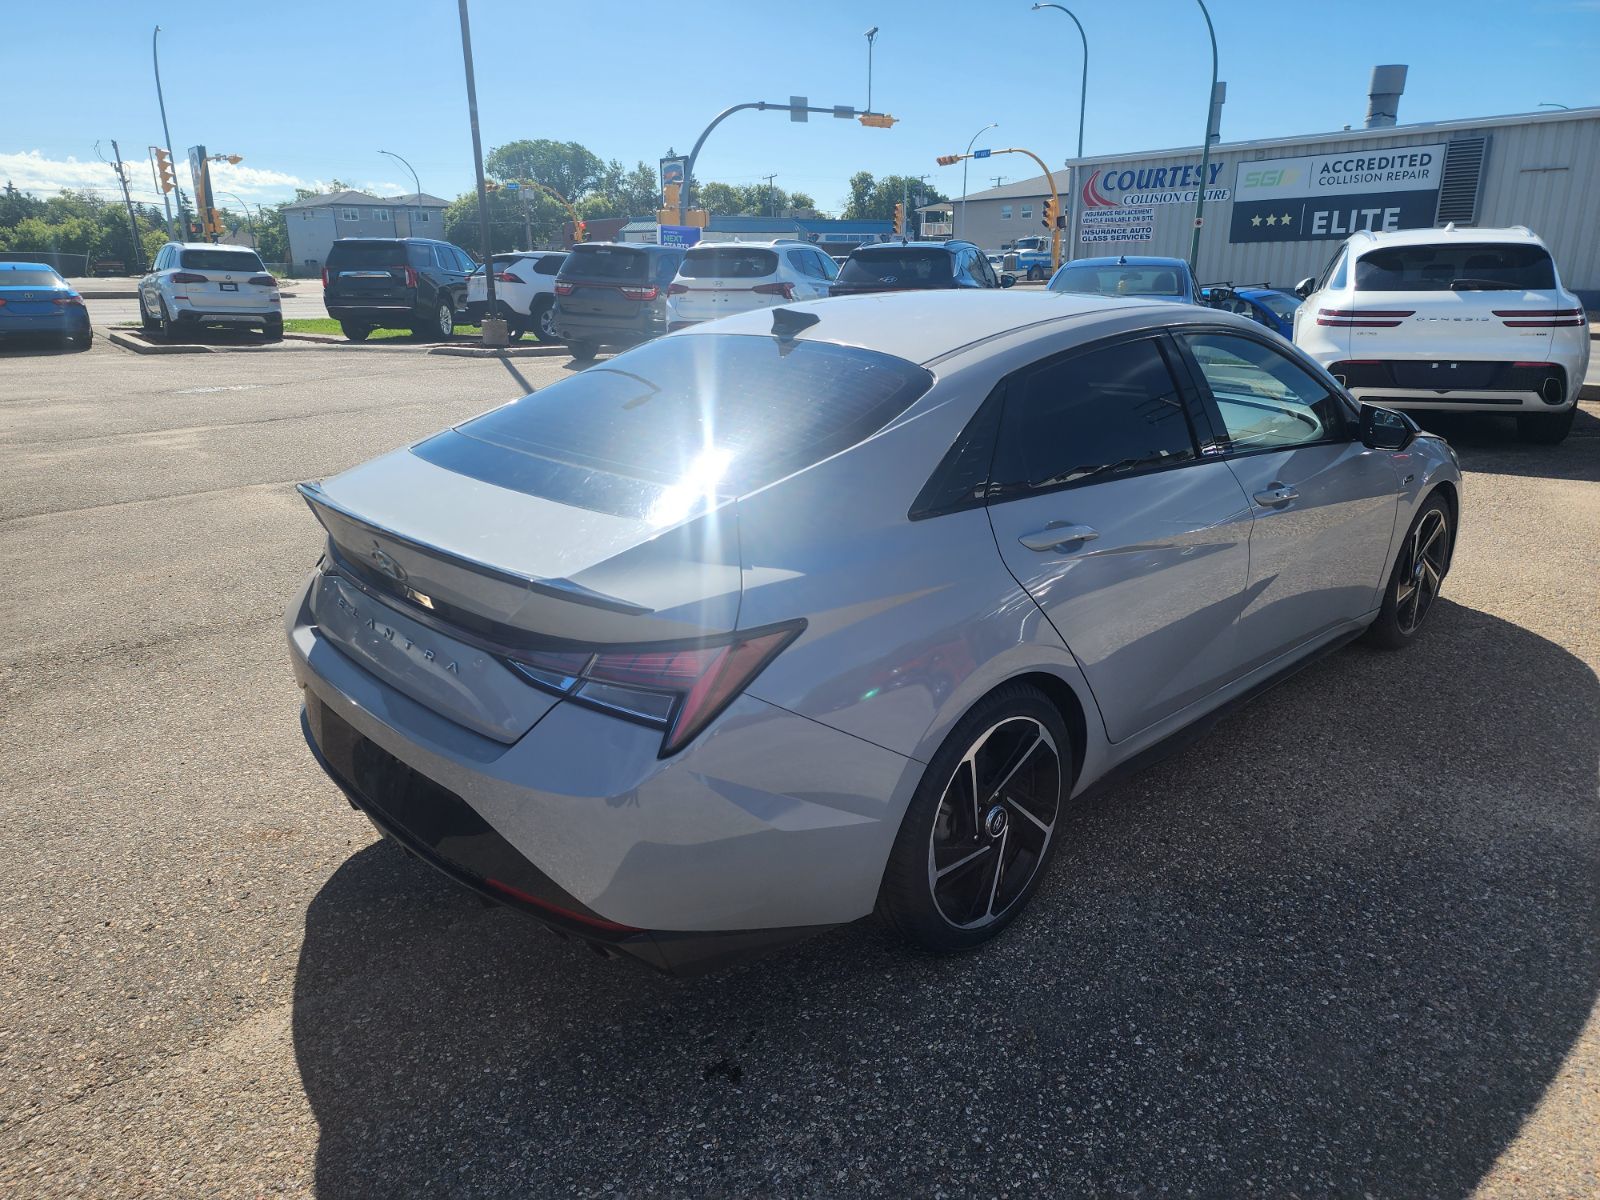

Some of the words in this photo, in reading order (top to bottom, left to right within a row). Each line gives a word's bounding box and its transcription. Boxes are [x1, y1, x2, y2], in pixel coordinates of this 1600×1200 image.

[1320, 153, 1432, 175] ACCREDITED
[1103, 163, 1224, 191] COURTESY
[1244, 169, 1285, 188] SGI
[1318, 172, 1383, 186] COLLISION
[1386, 169, 1429, 181] REPAIR
[1123, 192, 1182, 205] COLLISION
[1312, 207, 1401, 235] ELITE
[663, 235, 683, 243] NEXT
[1082, 228, 1127, 236] INSURANCE
[1130, 226, 1152, 234] AUTO
[1110, 233, 1151, 241] SERVICES
